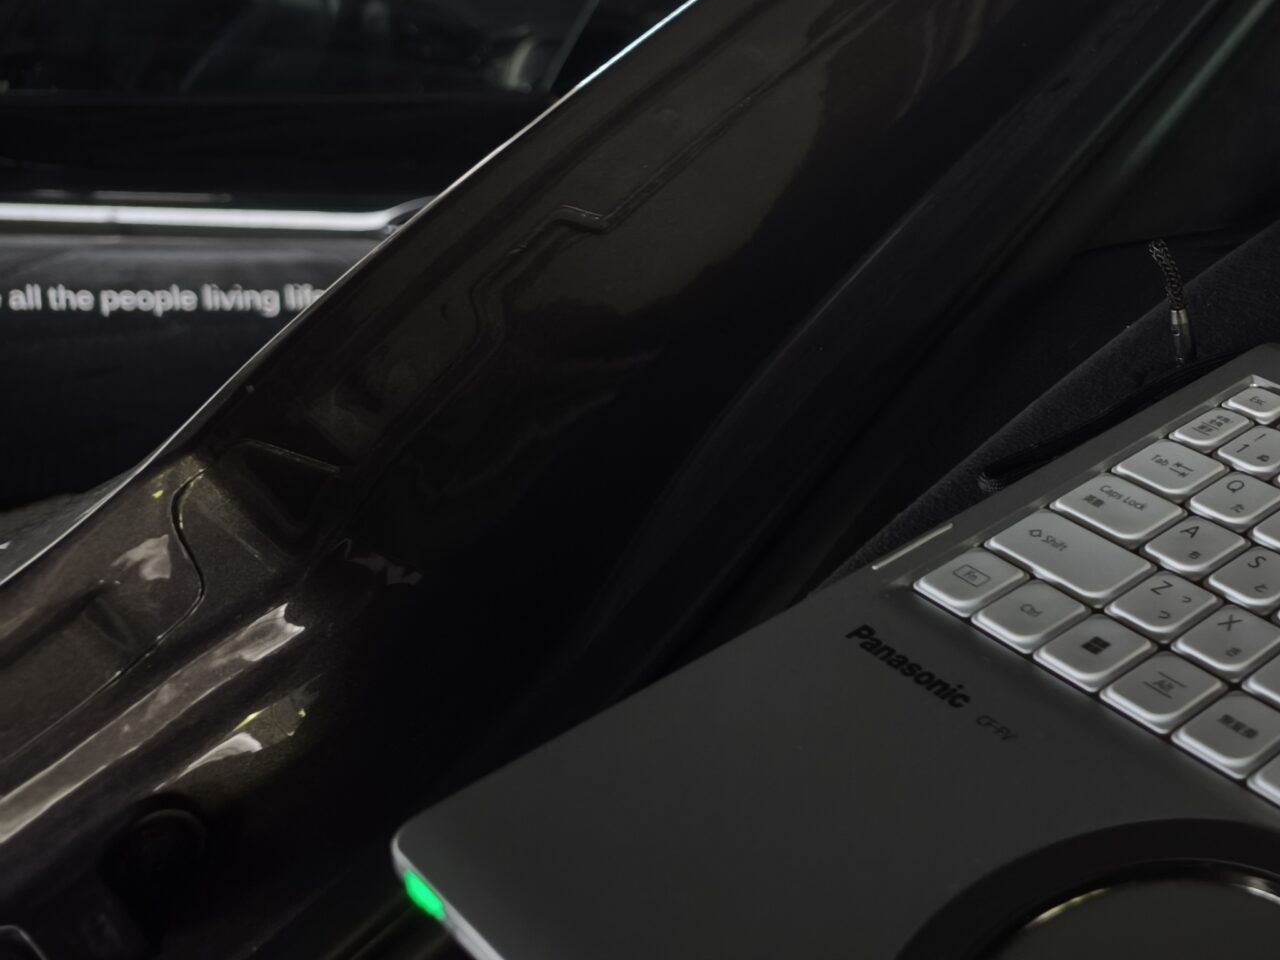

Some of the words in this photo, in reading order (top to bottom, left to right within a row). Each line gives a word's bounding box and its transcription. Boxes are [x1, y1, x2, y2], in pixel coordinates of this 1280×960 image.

[8, 283, 42, 311] all
[47, 283, 95, 311] the
[100, 283, 198, 317] people
[201, 283, 280, 318] living
[1249, 395, 1266, 406] Esc
[1151, 453, 1170, 467] Tab
[1226, 479, 1245, 494] Q
[1100, 485, 1122, 501] Caps
[1122, 496, 1148, 512] Lock
[1180, 525, 1200, 539] A
[1042, 531, 1069, 552] Shift
[1248, 555, 1266, 569] S
[1151, 580, 1173, 595] Z
[1020, 603, 1043, 619] Ctrl
[1218, 613, 1243, 632] X
[845, 624, 971, 708] Panasonic
